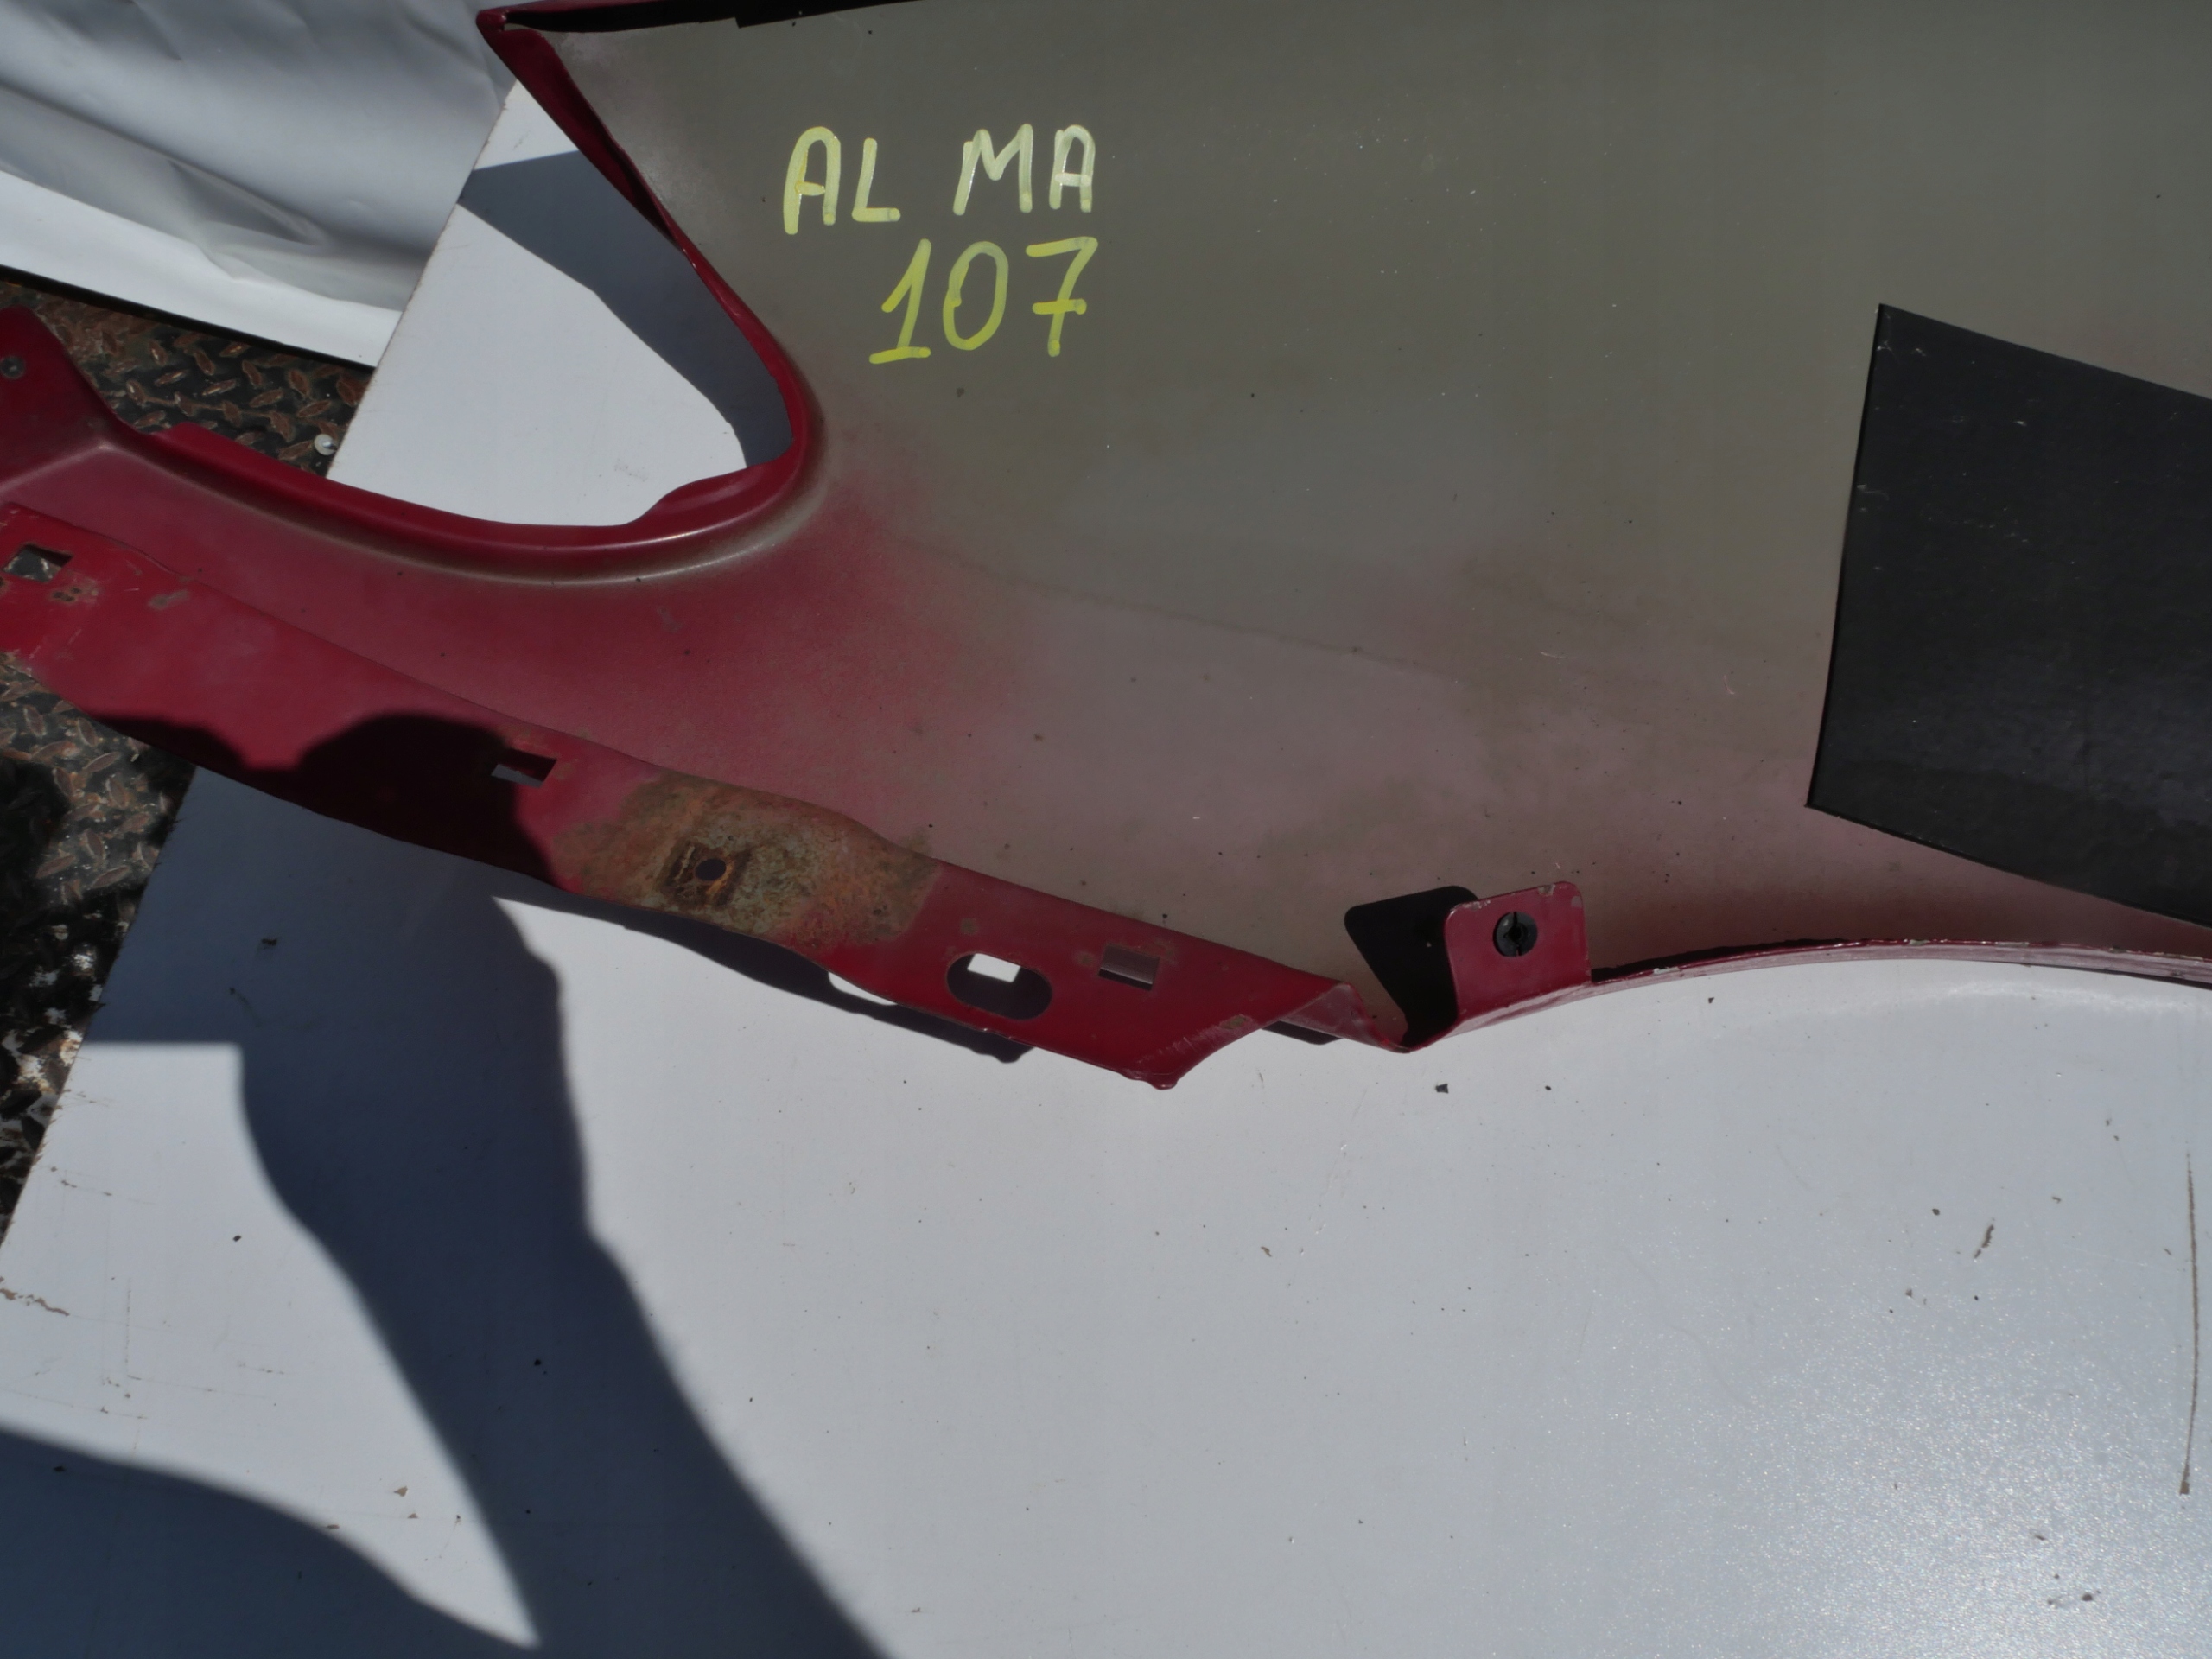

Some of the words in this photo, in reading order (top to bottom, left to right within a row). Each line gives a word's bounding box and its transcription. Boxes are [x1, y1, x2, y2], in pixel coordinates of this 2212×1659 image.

[783, 126, 900, 235] AL
[953, 124, 1096, 215] MA
[869, 237, 1098, 364] 107
